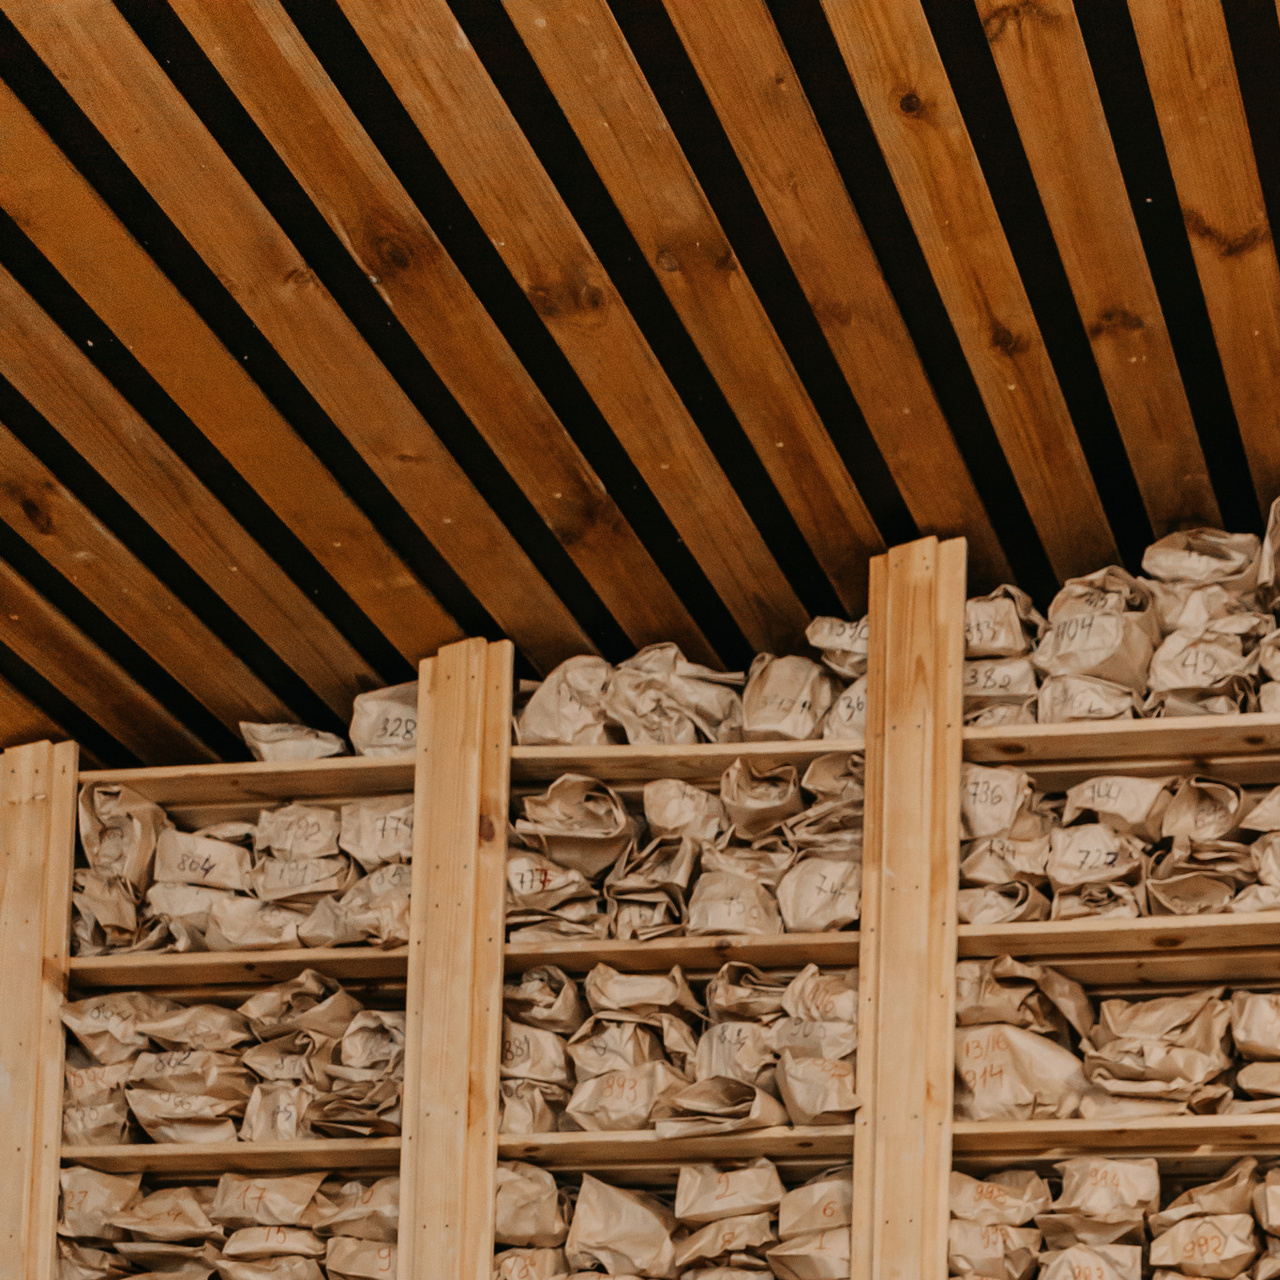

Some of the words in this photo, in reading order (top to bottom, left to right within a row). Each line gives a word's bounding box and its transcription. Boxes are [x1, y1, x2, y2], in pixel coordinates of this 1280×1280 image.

[1181, 650, 1216, 676] 42
[177, 853, 217, 878] 804
[715, 1172, 739, 1200] 2
[823, 1201, 837, 1218] 6
